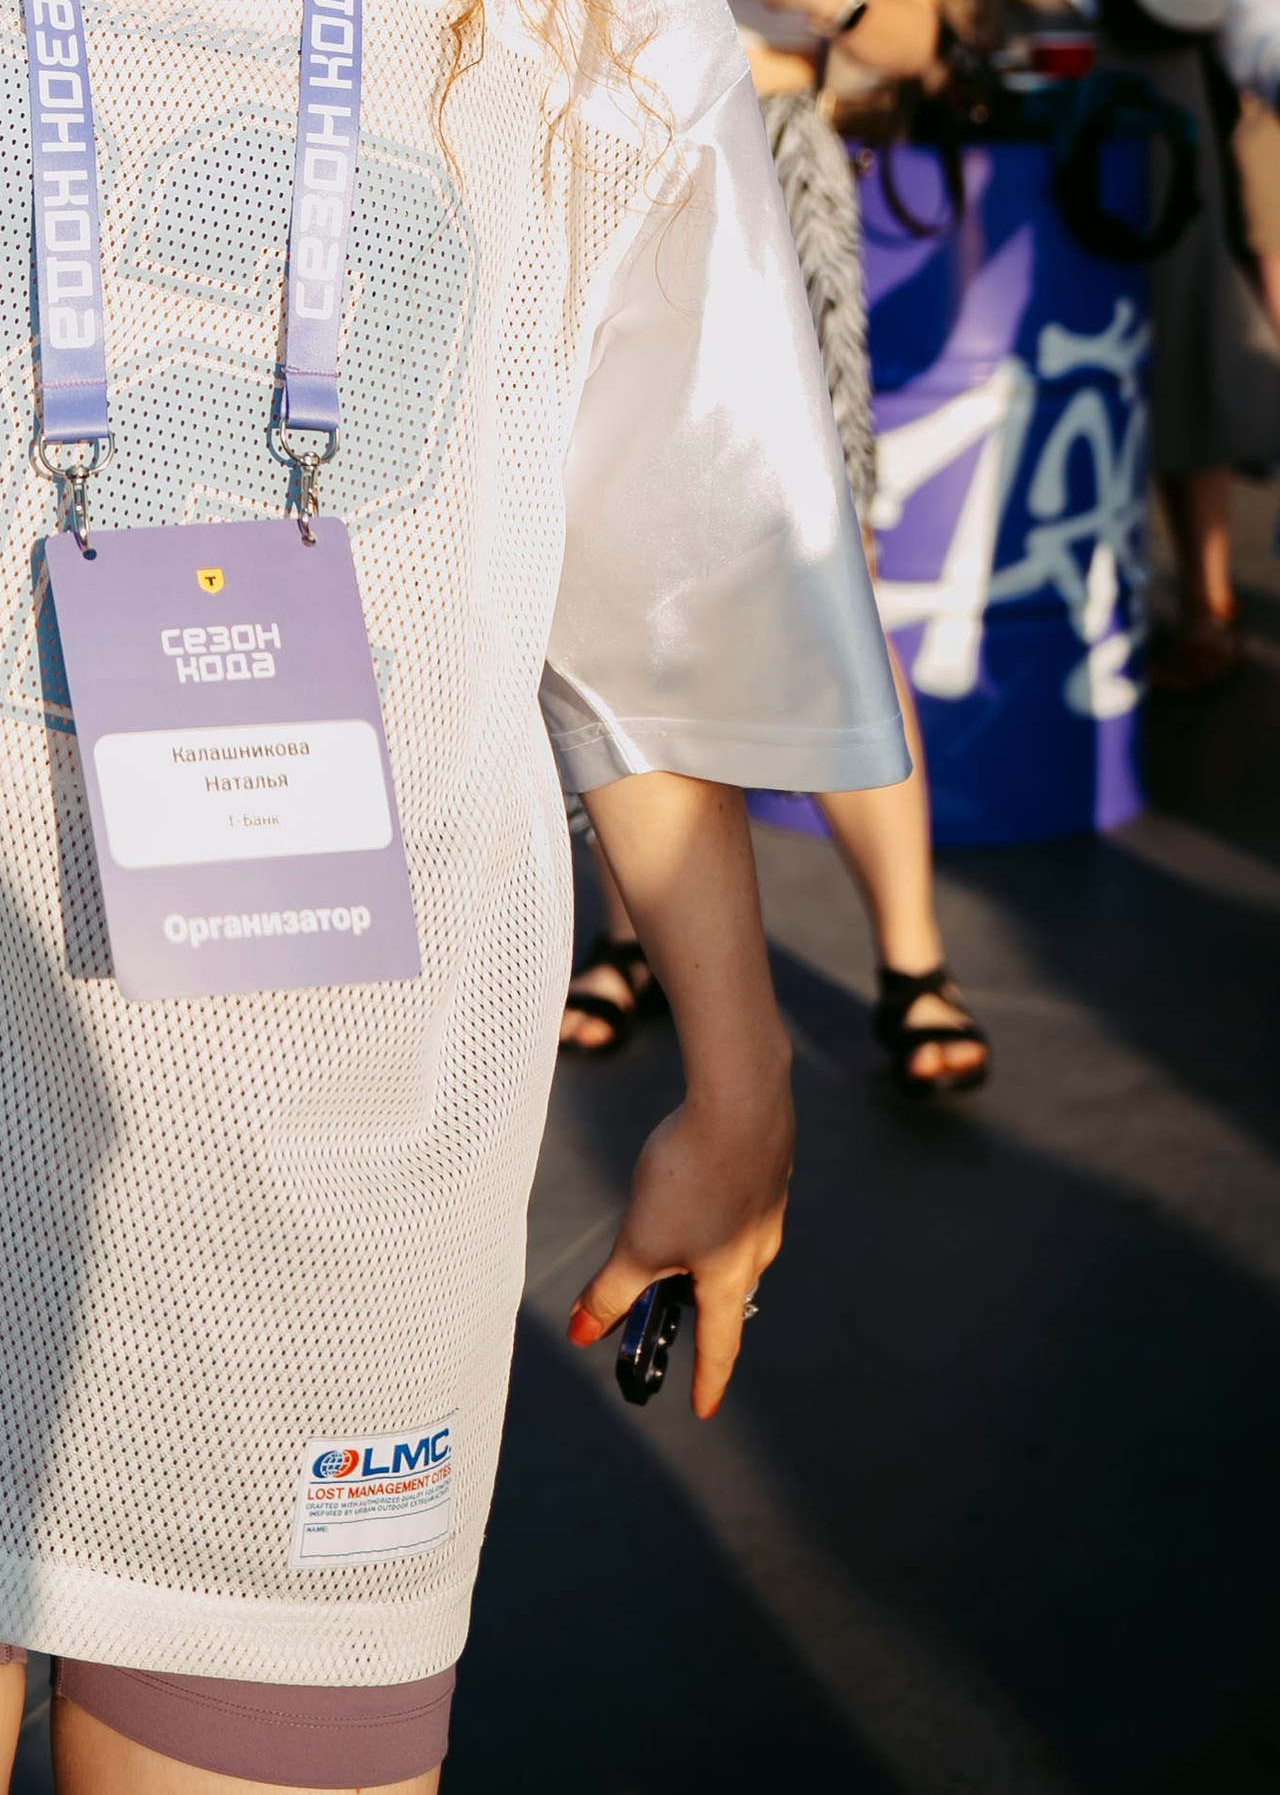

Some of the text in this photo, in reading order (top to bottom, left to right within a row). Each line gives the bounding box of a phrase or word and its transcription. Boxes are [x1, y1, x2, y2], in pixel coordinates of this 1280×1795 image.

[172, 740, 310, 764] Калашникова
[204, 773, 289, 793] Наталья
[227, 813, 280, 828] Т-Банк
[163, 905, 372, 947] Организатор
[307, 1488, 344, 1500] LOST
[347, 1474, 430, 1498] MANAGEMENT
